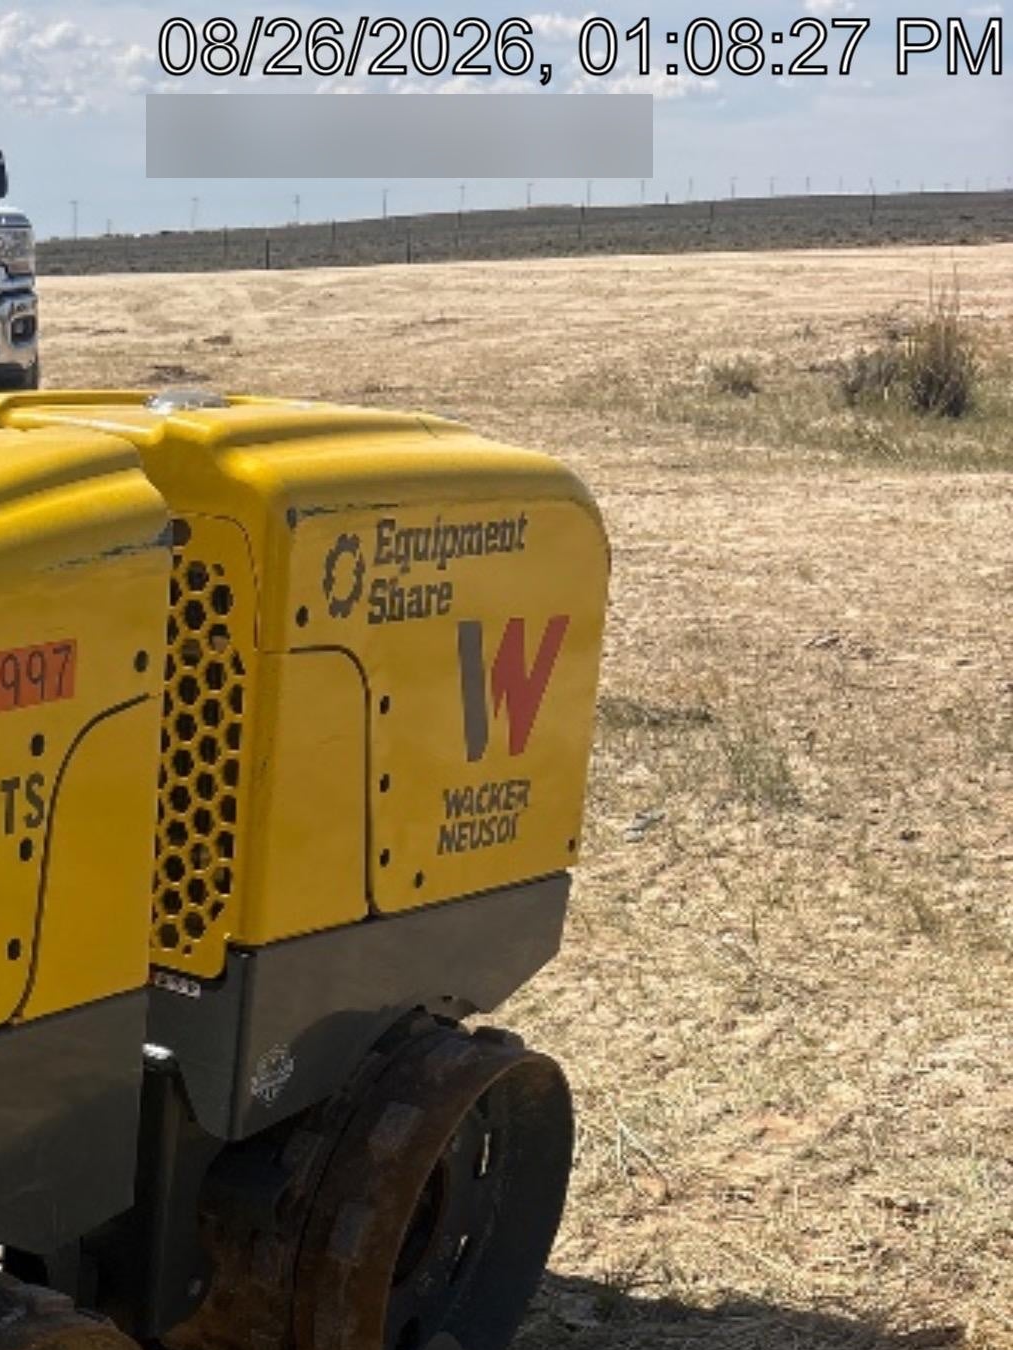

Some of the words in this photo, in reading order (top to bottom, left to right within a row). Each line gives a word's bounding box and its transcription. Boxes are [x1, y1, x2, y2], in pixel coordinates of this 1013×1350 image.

[374, 510, 529, 575] Equipment
[367, 576, 453, 625] Share
[442, 779, 531, 820] WACKER
